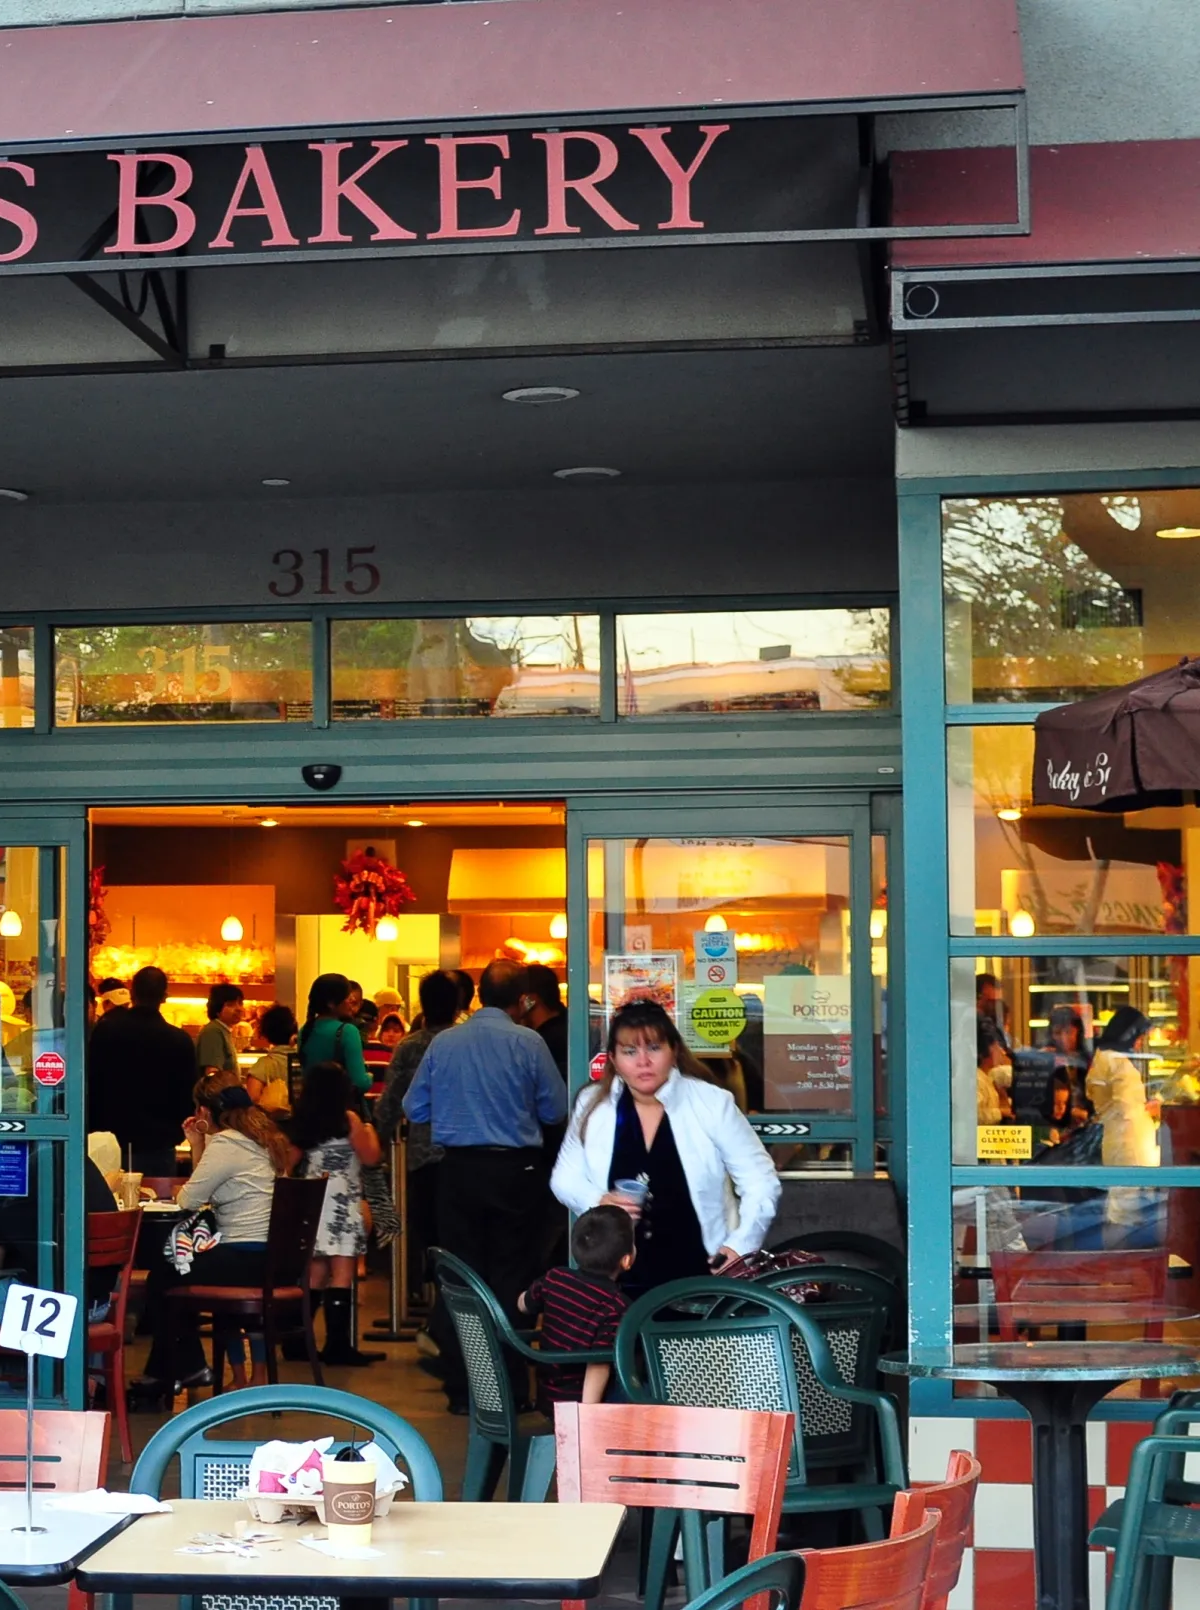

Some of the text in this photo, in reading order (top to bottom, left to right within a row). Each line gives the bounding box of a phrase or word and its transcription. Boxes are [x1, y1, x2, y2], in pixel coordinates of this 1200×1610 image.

[104, 124, 730, 254] BAKERY
[268, 545, 381, 597] 315
[137, 646, 232, 698] 315
[693, 1009, 744, 1019] CAUTION
[697, 1020, 741, 1028] AUTOMATIC
[21, 1293, 61, 1338] 12
